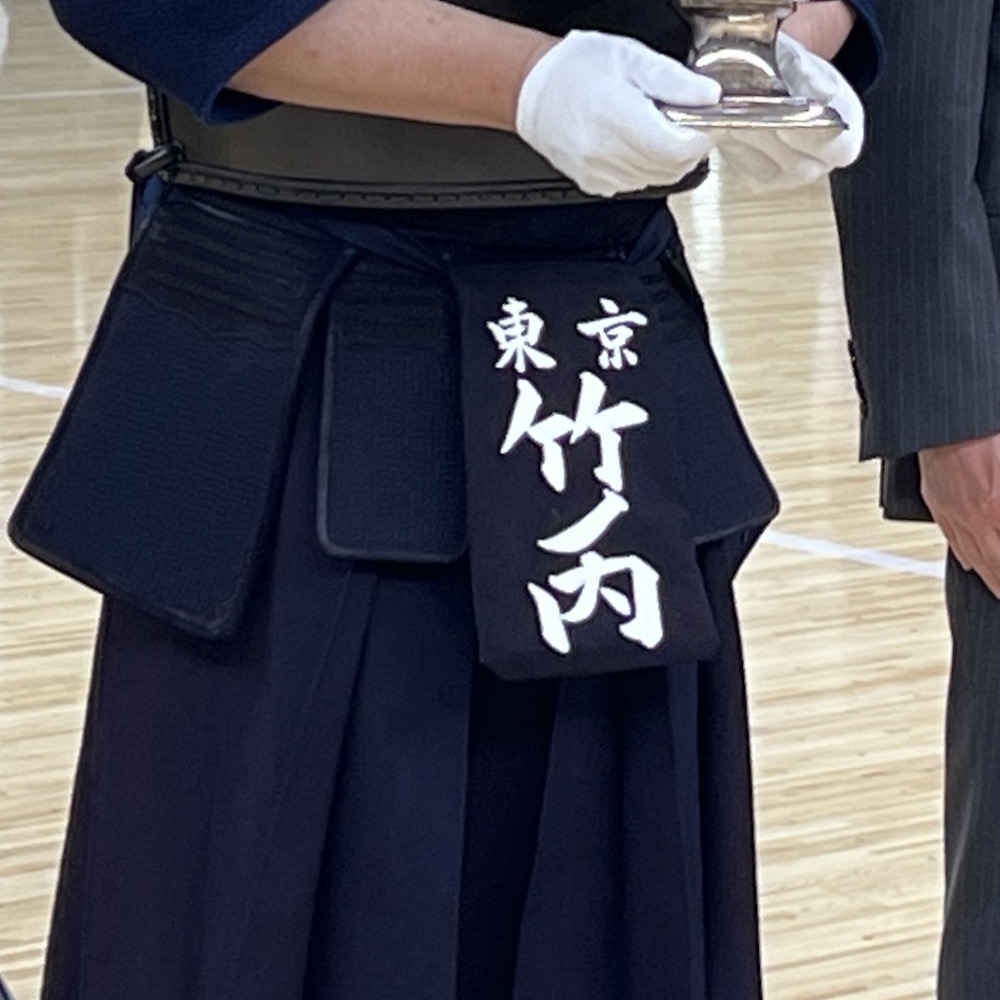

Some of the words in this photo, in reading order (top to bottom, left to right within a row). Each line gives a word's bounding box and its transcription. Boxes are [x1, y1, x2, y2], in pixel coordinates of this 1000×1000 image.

[487, 297, 649, 374] 東京
[500, 371, 664, 655] 竹ノ内
